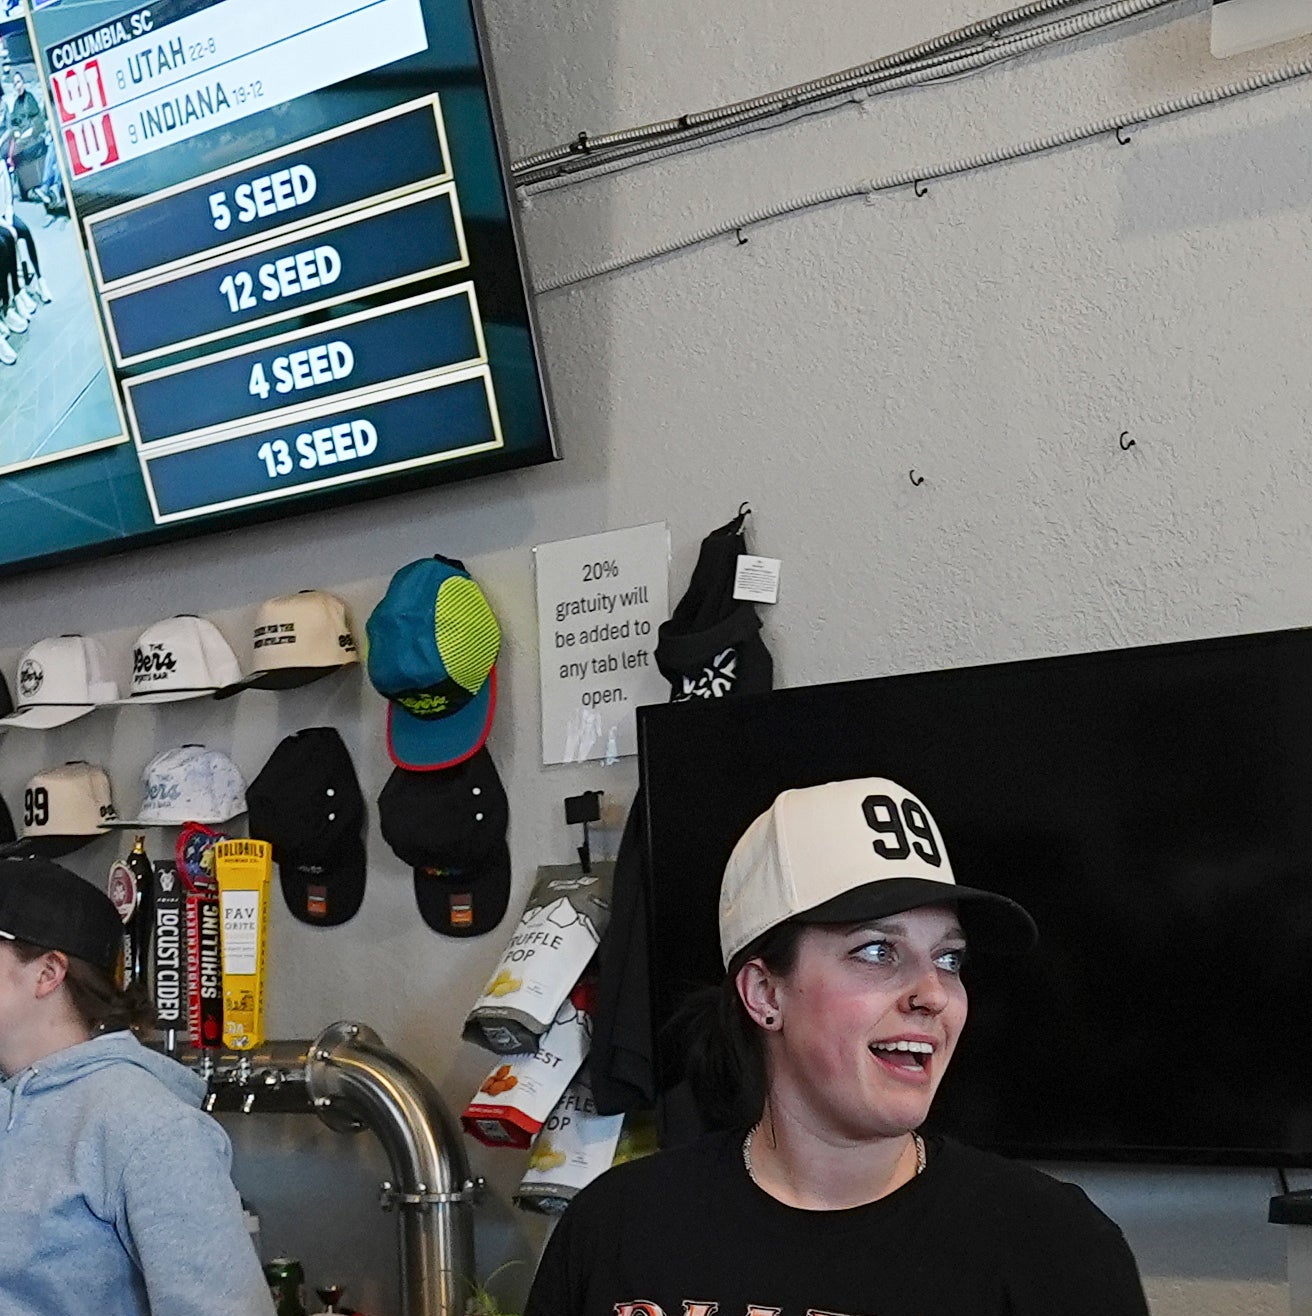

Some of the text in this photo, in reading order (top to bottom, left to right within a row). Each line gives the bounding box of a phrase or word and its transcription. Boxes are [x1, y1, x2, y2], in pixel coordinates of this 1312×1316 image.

[51, 10, 154, 70] COLUMBIA, SC
[116, 36, 217, 90] 8 UTAH 22-8
[128, 124, 138, 145] 9
[140, 81, 230, 141] INDIANA
[209, 164, 317, 231] 5 SEED
[219, 245, 342, 313] 12 SEED
[248, 341, 355, 399] 4 SEED
[257, 419, 378, 478] 13 SEED
[582, 559, 619, 583] 20%
[555, 586, 649, 622] gratuity will
[149, 643, 165, 651] THE
[555, 620, 651, 648] be added to
[559, 650, 649, 681] any tab left
[581, 687, 628, 709] open.
[24, 786, 49, 827] 99
[217, 841, 265, 859] HOLIDAILY
[861, 794, 942, 868] 99
[224, 922, 255, 930] ORITE
[225, 908, 255, 918] FAV
[157, 908, 179, 970] LOCUST
[201, 904, 218, 998] SCHILLING
[507, 931, 564, 950] RUFFLE
[157, 971, 179, 1021] CIDER
